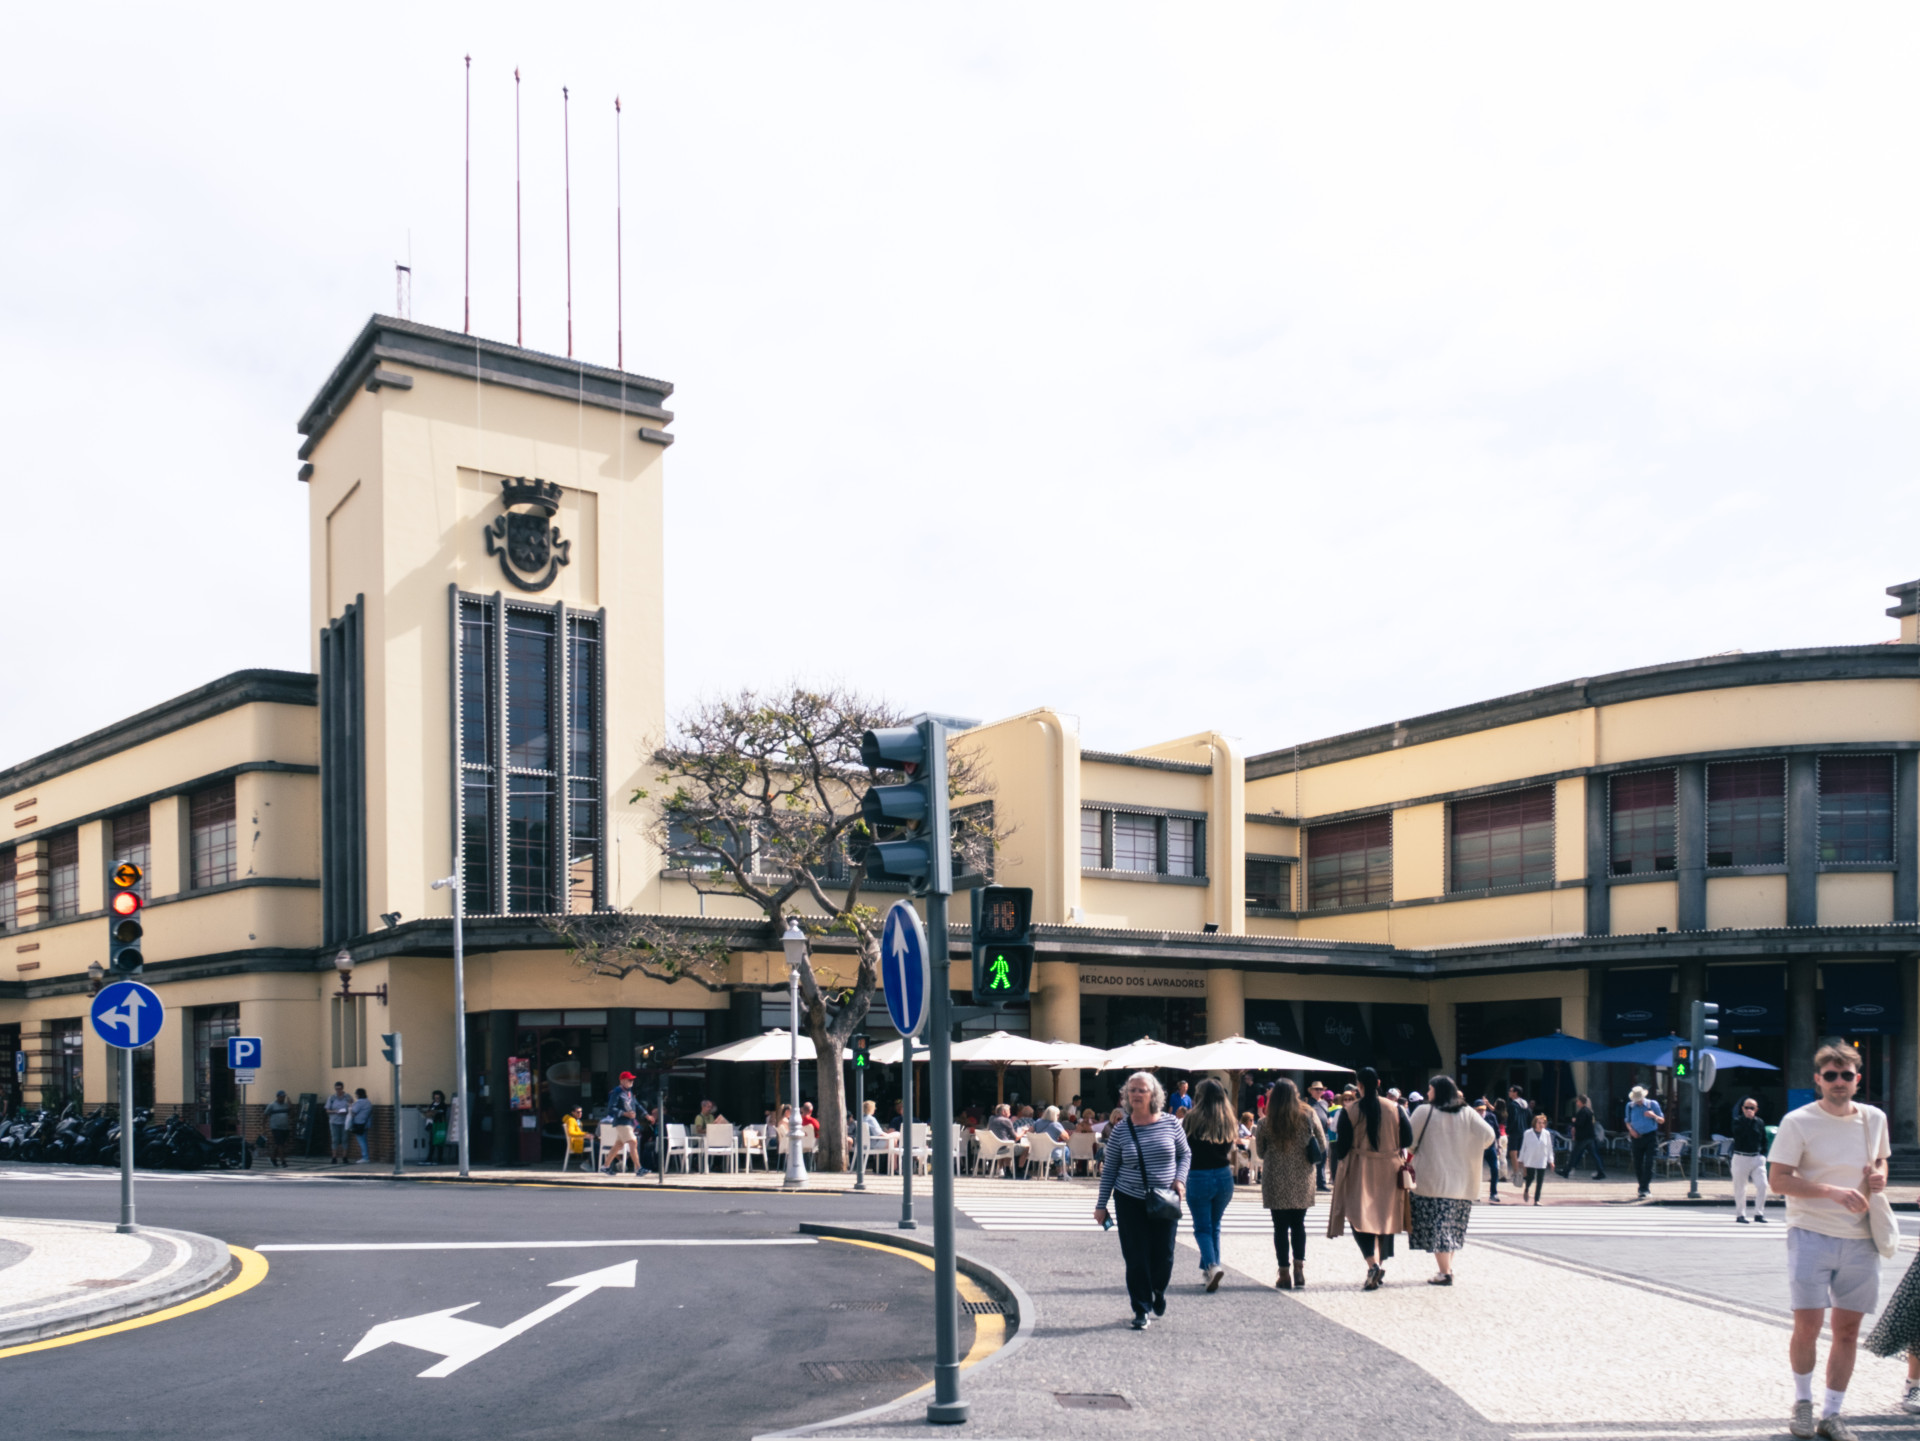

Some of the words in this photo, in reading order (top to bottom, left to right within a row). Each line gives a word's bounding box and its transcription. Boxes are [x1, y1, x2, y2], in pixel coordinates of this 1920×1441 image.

[1080, 974, 1123, 985] MERCADO
[1126, 976, 1144, 986] DOS
[1147, 978, 1205, 988] LAVRADORES
[16, 1053, 23, 1071] P
[235, 1040, 255, 1066] P
